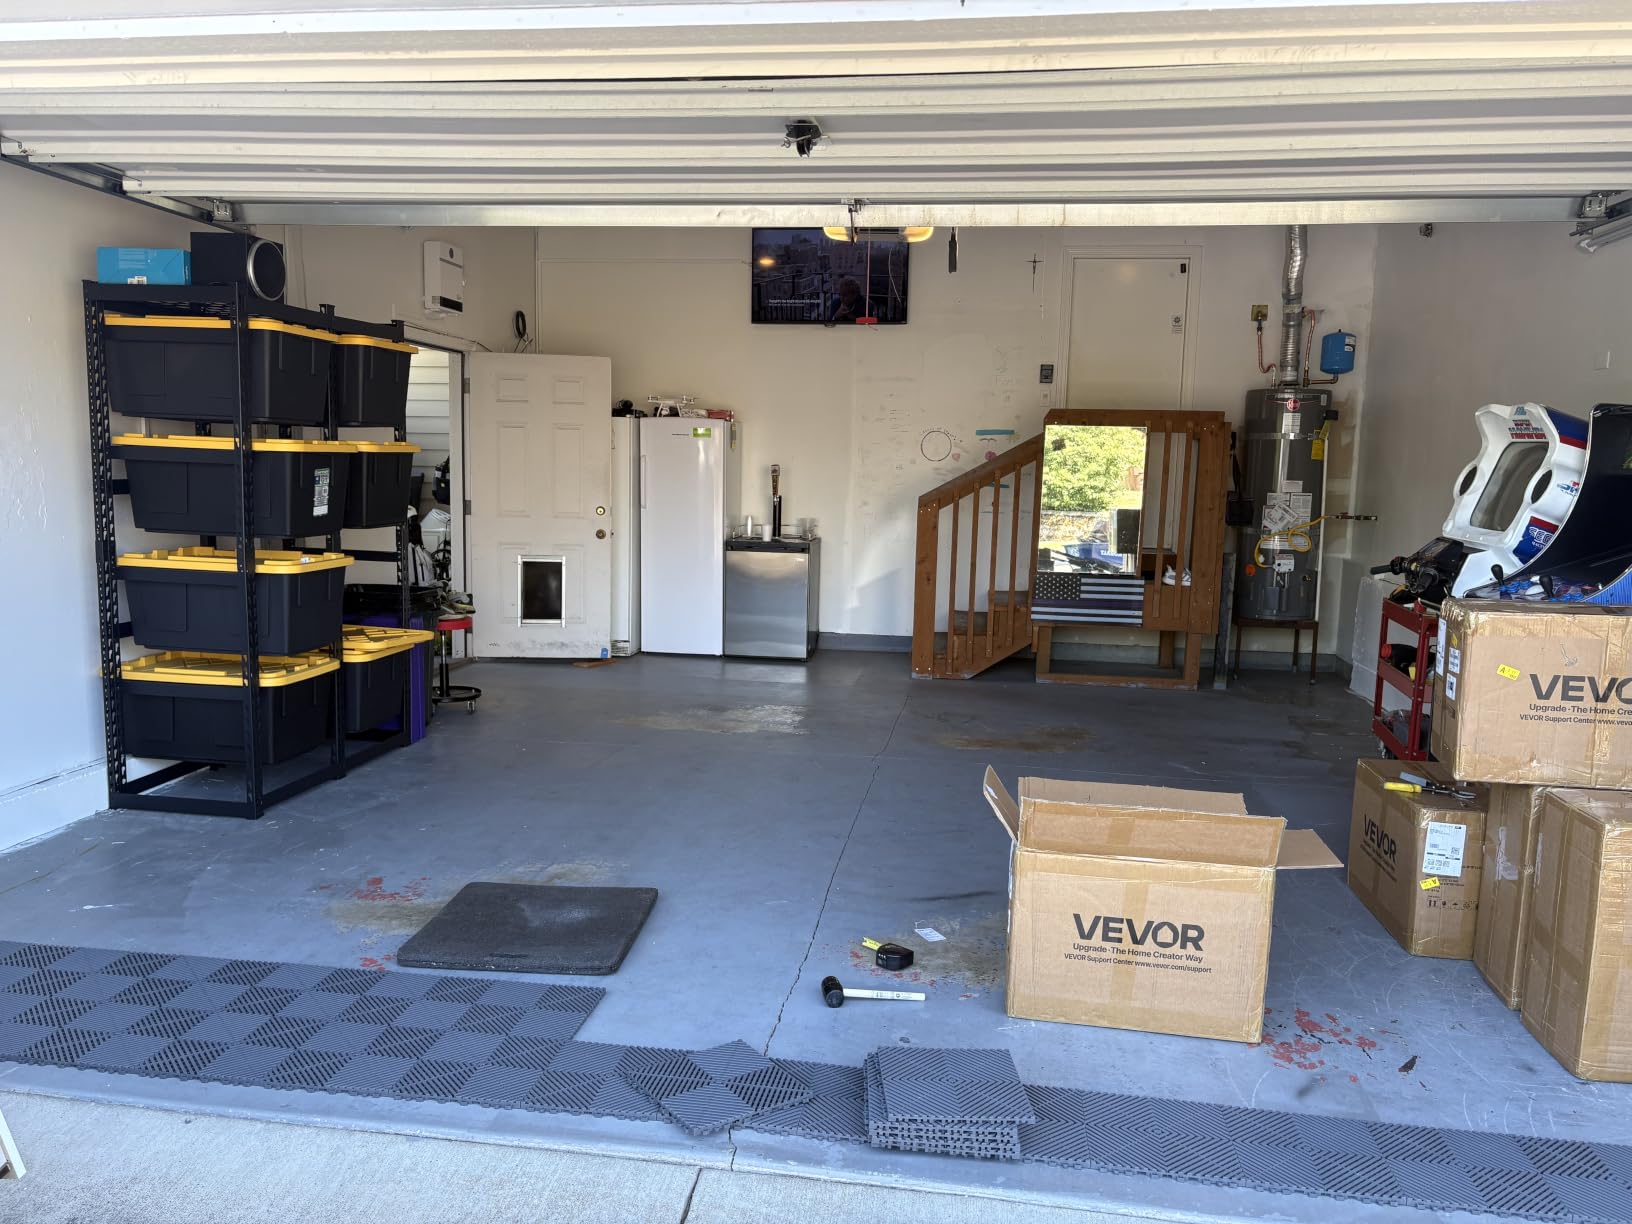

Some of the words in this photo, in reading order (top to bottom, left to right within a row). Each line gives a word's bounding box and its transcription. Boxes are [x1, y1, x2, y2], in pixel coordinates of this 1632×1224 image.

[1528, 526, 1553, 545] SEG
[1529, 673, 1632, 704] VEVO
[1520, 713, 1544, 721] VEVOR
[1545, 715, 1572, 723] Support
[1573, 716, 1596, 724] Center
[1529, 703, 1567, 713] Upgrade
[1571, 705, 1588, 714] The
[1589, 706, 1615, 715] Home
[1617, 707, 1632, 716] Cre
[1364, 813, 1397, 865] VEVOR
[1072, 913, 1205, 951] VEVOR
[1073, 943, 1107, 953] Upgrade
[1111, 946, 1127, 955] The
[1127, 948, 1152, 957] Home
[1153, 951, 1184, 960] Creator
[1185, 954, 1203, 963] Way
[1087, 955, 1112, 963] Support
[1135, 960, 1212, 973] www.vevor.com/support
